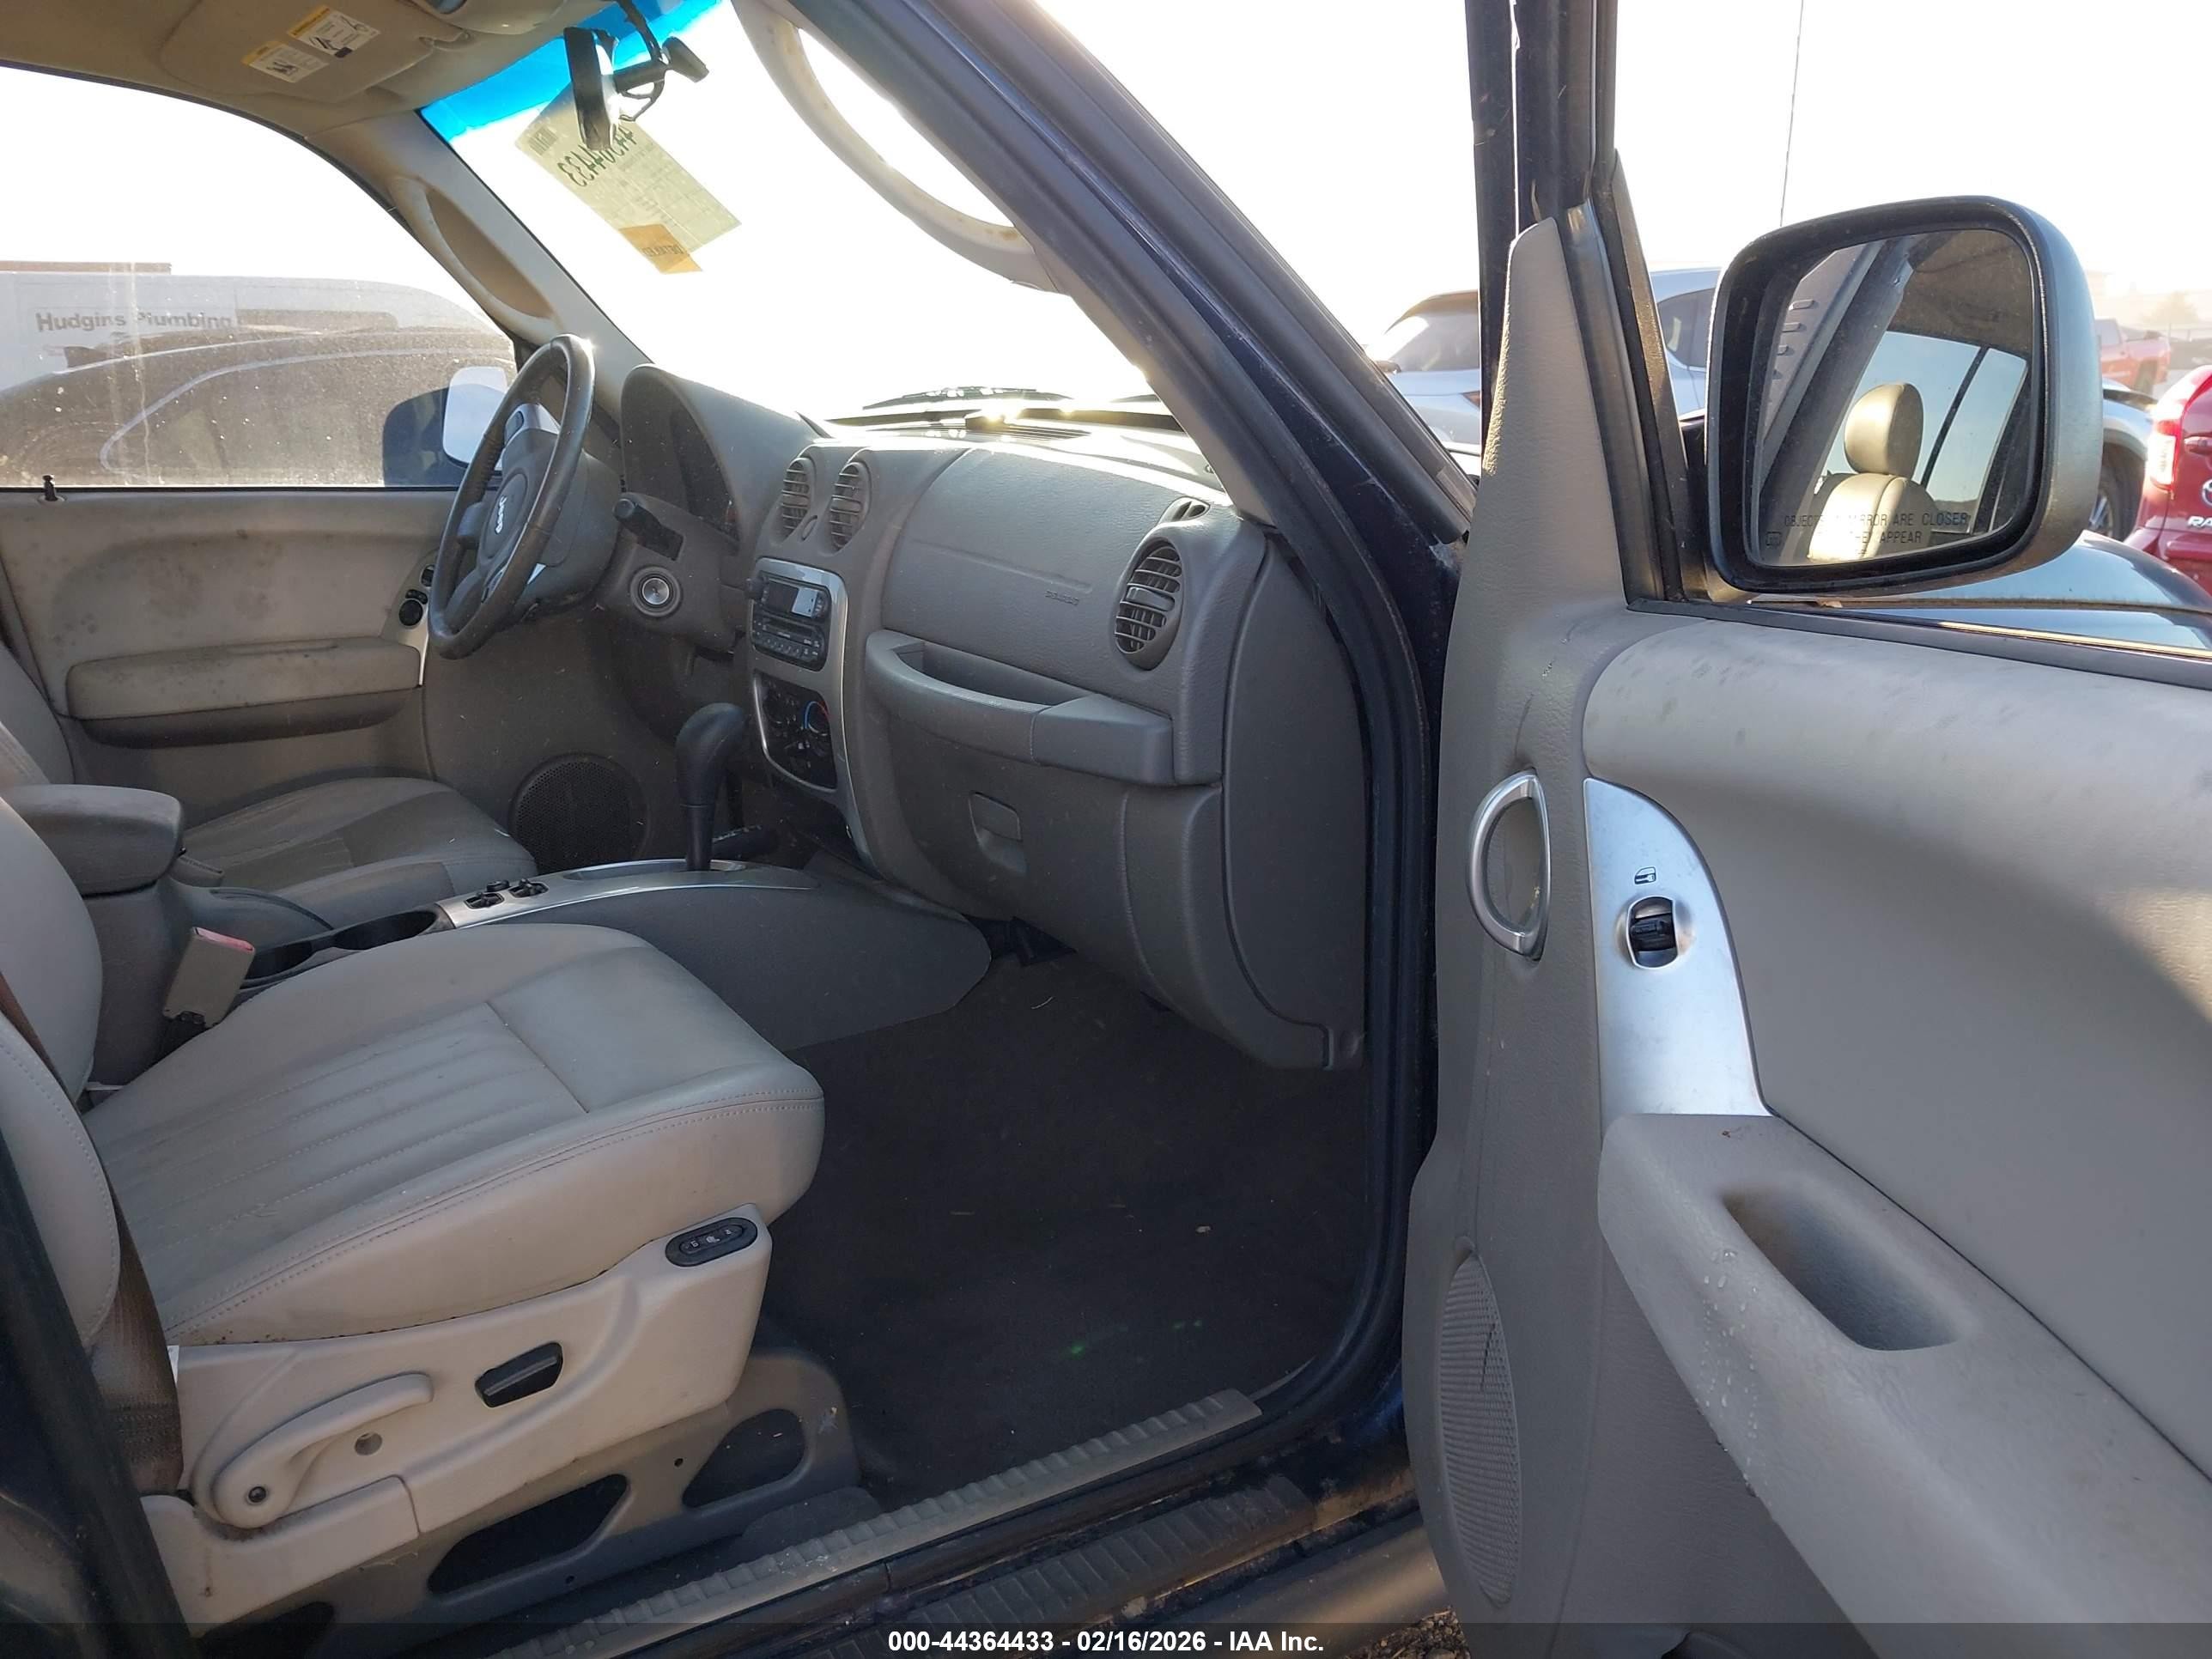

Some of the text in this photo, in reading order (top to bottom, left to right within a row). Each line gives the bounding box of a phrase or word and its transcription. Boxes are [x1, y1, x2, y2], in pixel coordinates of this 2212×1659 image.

[37, 313, 126, 331] Hudgins
[1848, 514, 1887, 526] RROR
[1893, 513, 1914, 526] ARE
[1922, 512, 1971, 526] CLOSER
[1879, 531, 1923, 544] APPEAR
